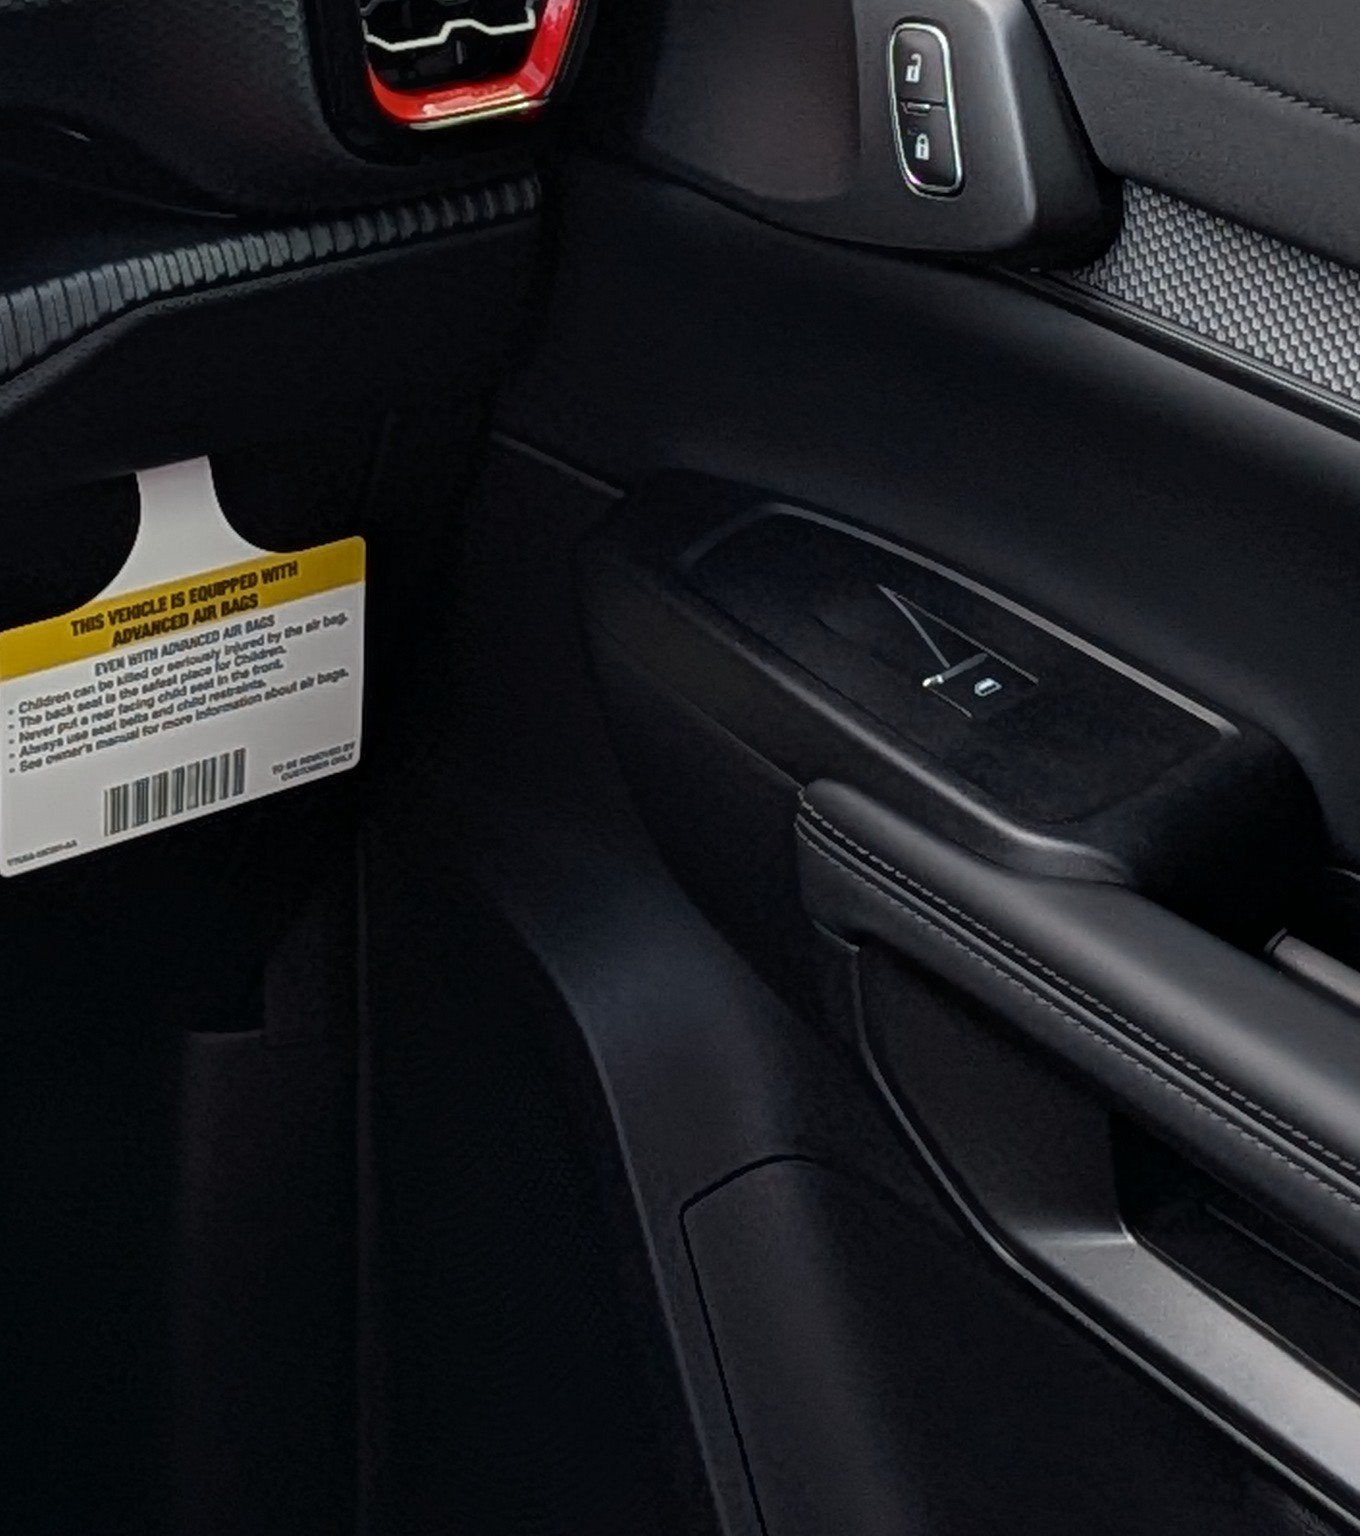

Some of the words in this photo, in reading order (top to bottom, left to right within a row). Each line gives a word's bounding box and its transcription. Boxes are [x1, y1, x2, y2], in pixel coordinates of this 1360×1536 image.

[71, 613, 104, 636] THIS
[108, 596, 167, 625] VEHICLE
[171, 591, 185, 609] IS
[189, 572, 258, 604] EQUIPPED
[261, 561, 298, 584] WITH
[112, 613, 189, 647] ADVANCED
[192, 605, 217, 625] AIR
[221, 593, 258, 617] BAGS
[19, 692, 71, 714] Children
[73, 685, 95, 698] can
[98, 680, 114, 692] be
[117, 667, 148, 686] killed
[152, 665, 164, 676] or
[167, 649, 221, 675] seriously
[267, 632, 282, 644] by
[285, 626, 303, 638] the
[306, 619, 321, 633] air
[95, 657, 125, 676] EVEN
[128, 648, 158, 666] WITH
[161, 630, 220, 657] ADVANCED
[223, 624, 242, 640] AIR
[246, 615, 275, 634] BAGS
[19, 715, 42, 728] The
[45, 705, 74, 721] back
[77, 696, 102, 712] seat
[105, 694, 116, 704] is
[119, 688, 139, 700] the
[181, 666, 212, 684] place
[215, 659, 231, 672] for
[19, 725, 54, 743] Never
[57, 717, 78, 735] put
[81, 717, 88, 725] a
[91, 708, 115, 723] rear
[118, 697, 155, 715] facing
[158, 686, 187, 703] child
[190, 678, 214, 694] seat
[217, 675, 228, 686] in
[231, 669, 250, 682] the
[19, 738, 64, 758] Always
[67, 731, 89, 744] use
[92, 721, 117, 736] seat
[120, 713, 149, 729] belts
[152, 703, 174, 719] and
[177, 694, 206, 712] child
[20, 758, 42, 772] See
[46, 744, 93, 764] owner's
[96, 727, 139, 750] manual
[142, 724, 159, 736] for
[162, 715, 193, 731] more
[196, 694, 262, 720] information
[264, 681, 297, 700] about
[300, 677, 314, 690] air
